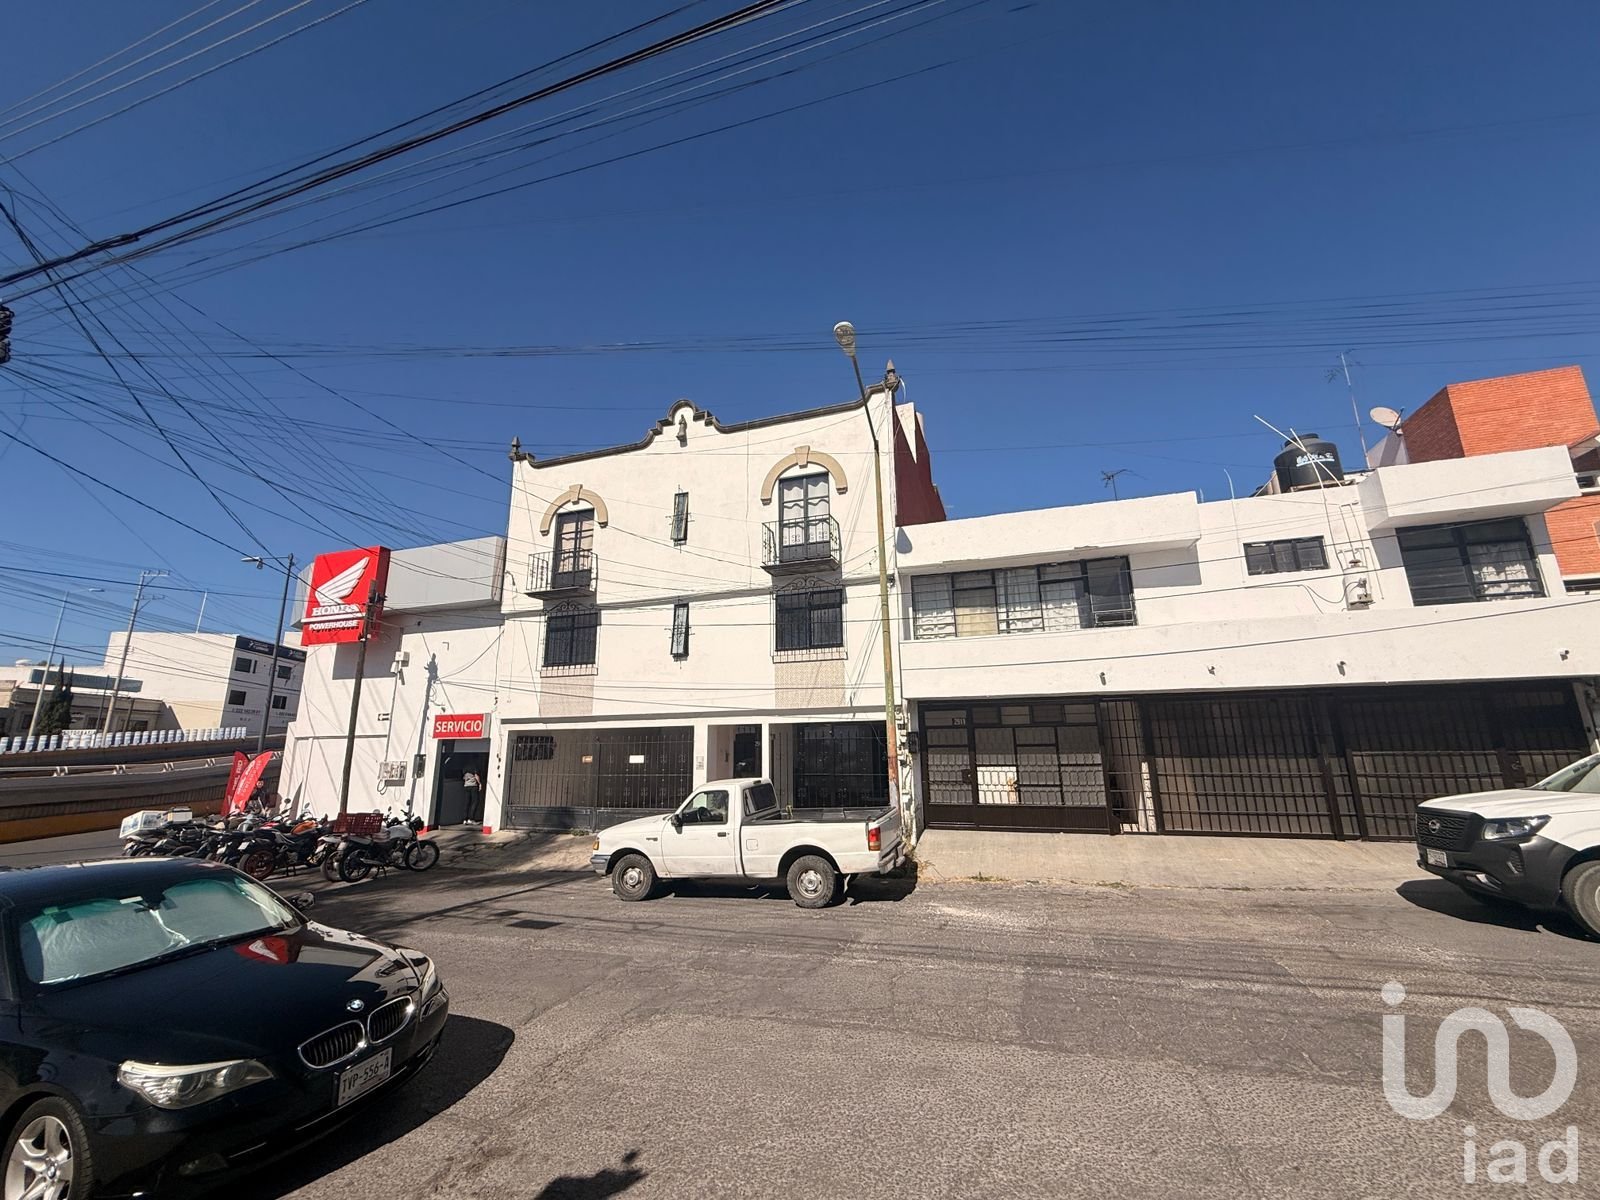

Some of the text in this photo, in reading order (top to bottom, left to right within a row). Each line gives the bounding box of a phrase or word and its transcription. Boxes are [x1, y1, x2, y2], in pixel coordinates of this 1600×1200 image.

[309, 620, 359, 631] POWERHOUSE
[435, 720, 482, 733] SERVICIO
[342, 1055, 390, 1094] TVP-556-A
